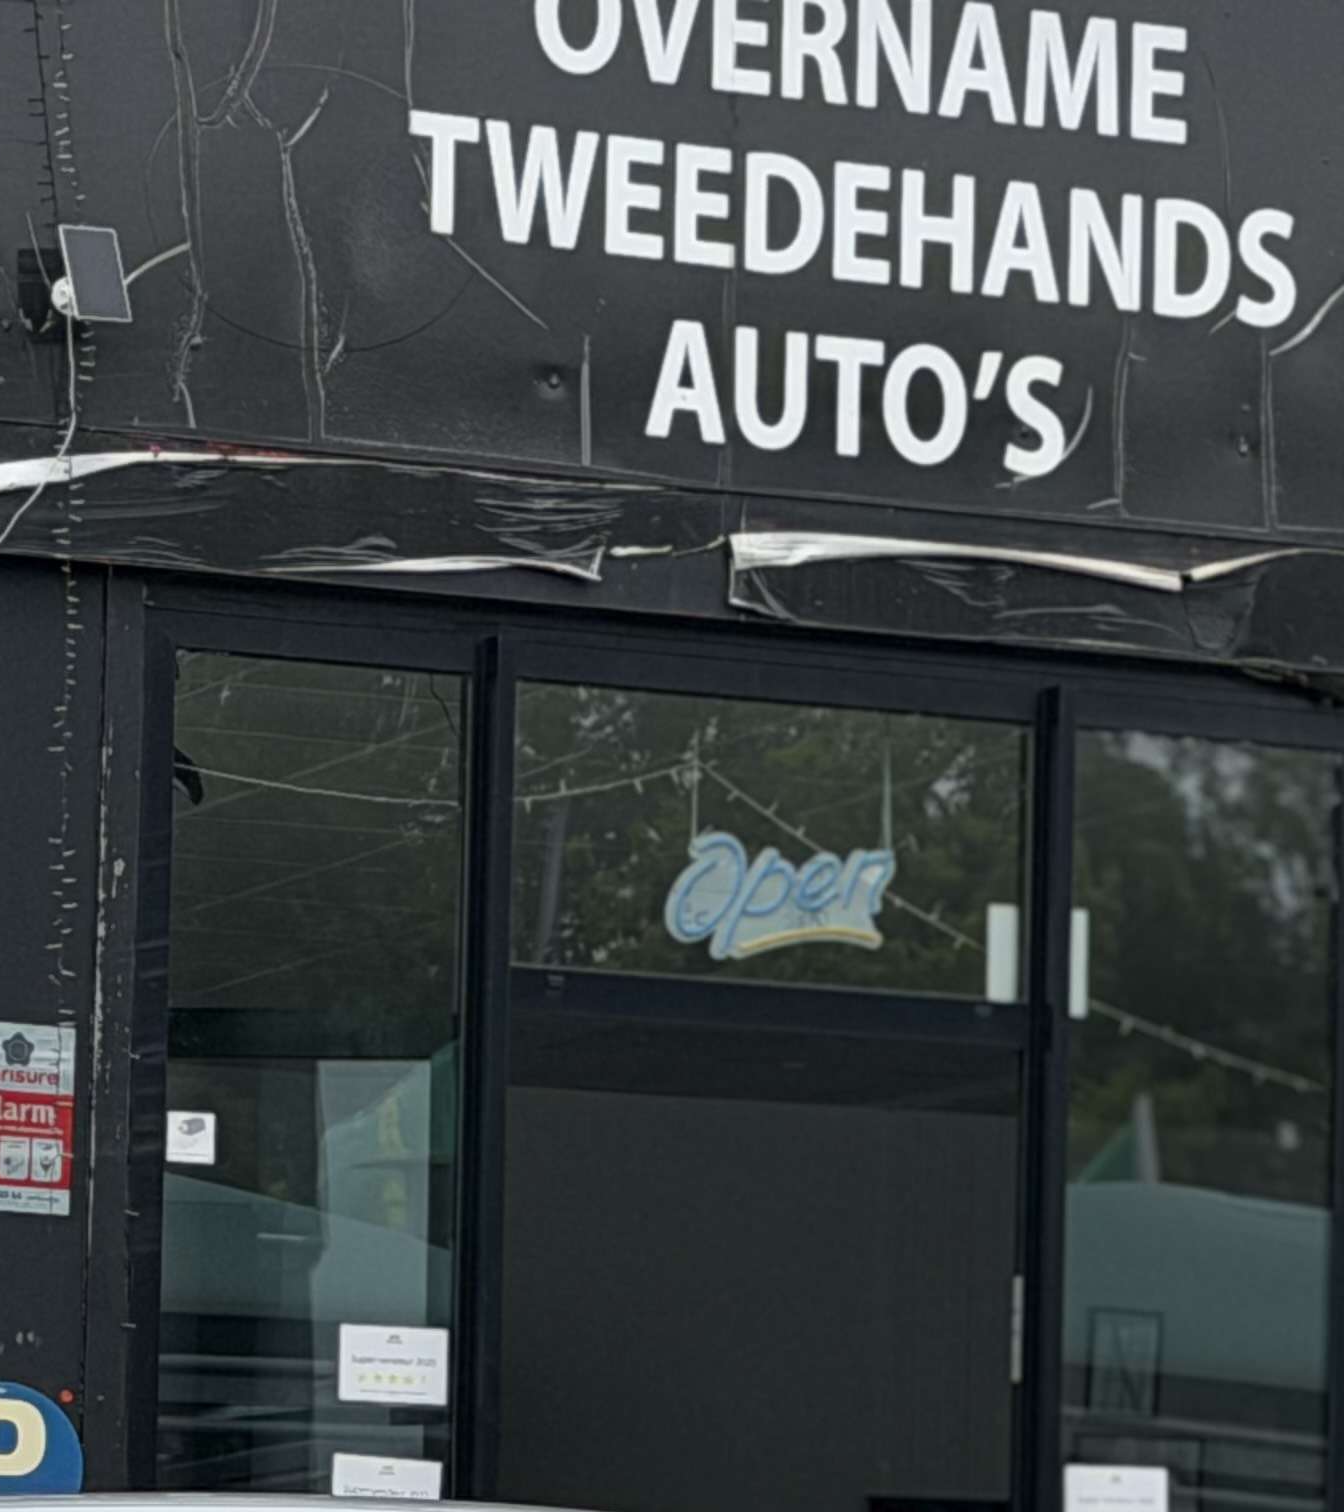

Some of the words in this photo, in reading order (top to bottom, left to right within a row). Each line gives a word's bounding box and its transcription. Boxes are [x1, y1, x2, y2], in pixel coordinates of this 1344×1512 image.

[533, 0, 1188, 144] OVERNAME
[409, 109, 1297, 326] TWEEDEHANDS
[646, 319, 1064, 478] AUTO'S
[665, 832, 896, 960] Open
